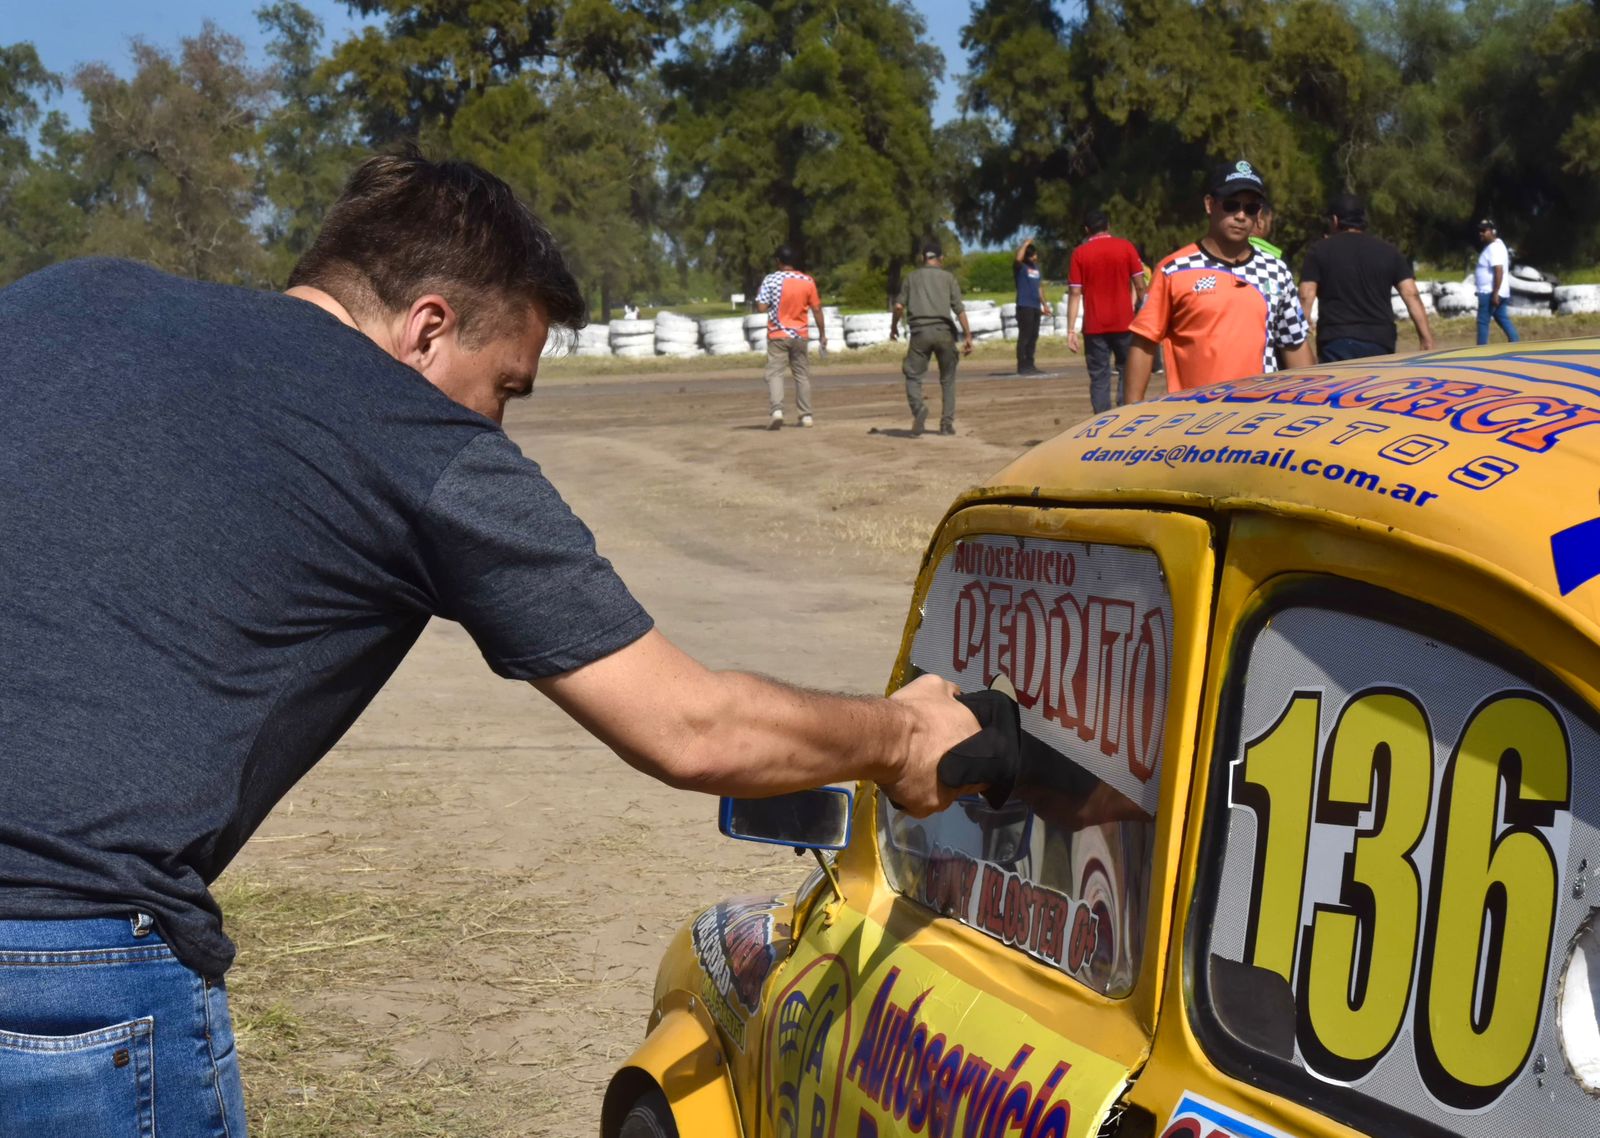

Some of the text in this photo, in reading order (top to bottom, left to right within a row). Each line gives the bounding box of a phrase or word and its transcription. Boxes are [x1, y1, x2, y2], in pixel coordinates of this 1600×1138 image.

[1073, 412, 1519, 490] REPUESTOS
[1080, 444, 1438, 507] danigis@hotmail.com.ar
[955, 542, 1076, 588] AUTOSERVICIO
[952, 579, 1168, 784] PEDRITO
[976, 863, 1069, 966] KLOSTER
[1231, 684, 1573, 1109] 136
